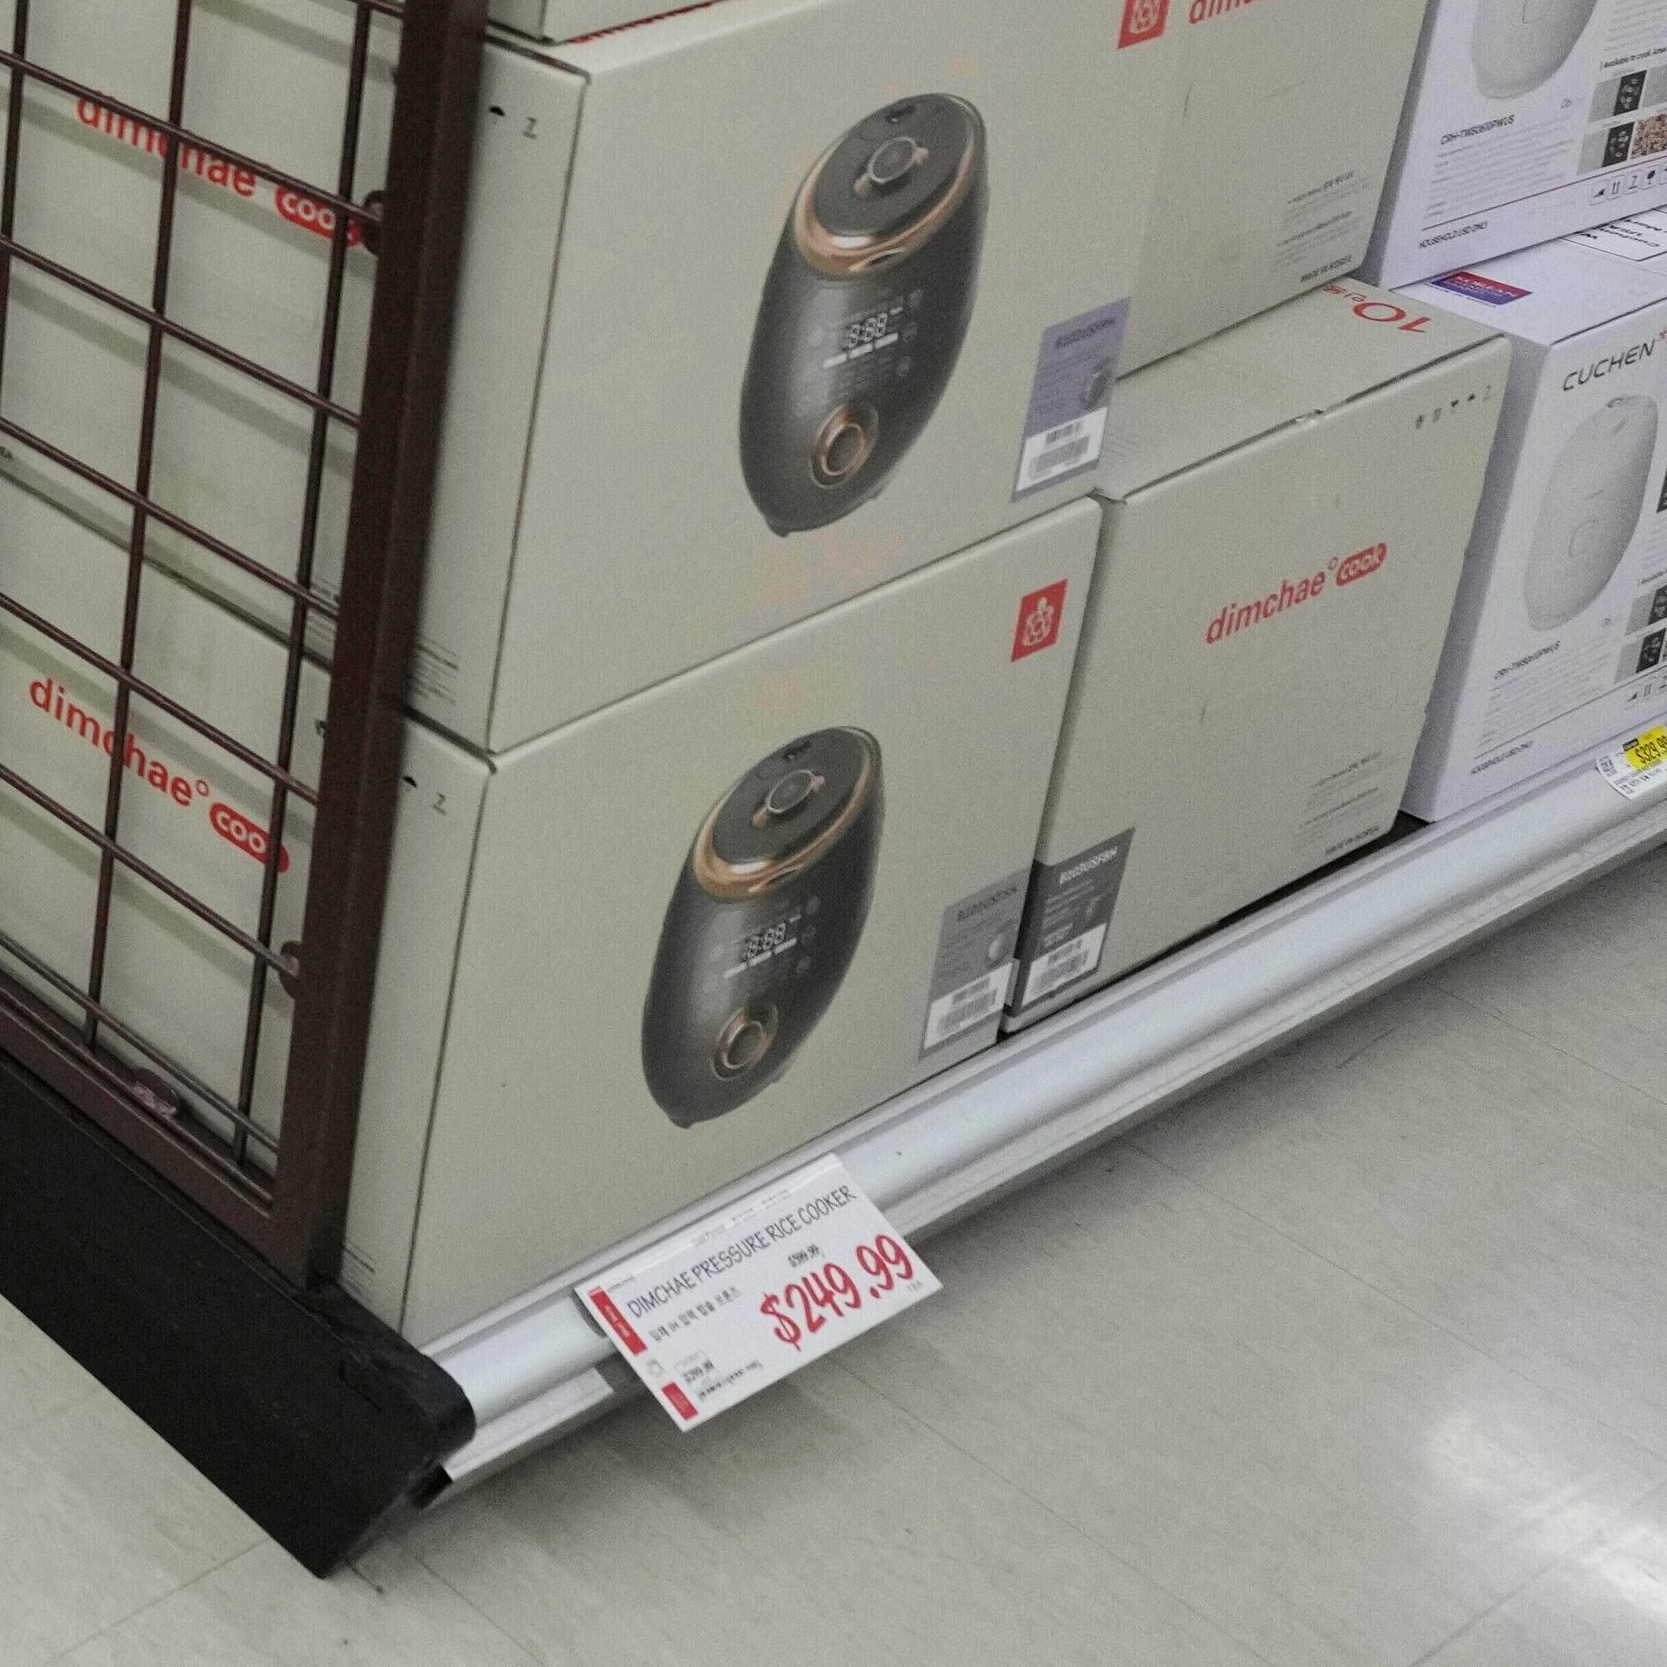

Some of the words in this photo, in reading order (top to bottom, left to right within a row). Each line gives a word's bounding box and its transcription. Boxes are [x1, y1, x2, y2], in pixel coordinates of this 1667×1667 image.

[77, 92, 257, 198] dimae
[283, 188, 334, 233] coo
[1353, 301, 1431, 334] 10
[1562, 338, 1656, 392] CUCHEN
[1206, 567, 1328, 645] dimchae
[214, 804, 268, 856] coo
[627, 1269, 697, 1318] DIMCHAE
[694, 1230, 770, 1283] PRESSURE
[768, 1213, 803, 1249] RICE
[798, 1184, 858, 1226] COOKER
[760, 1233, 914, 1352] $249.99
